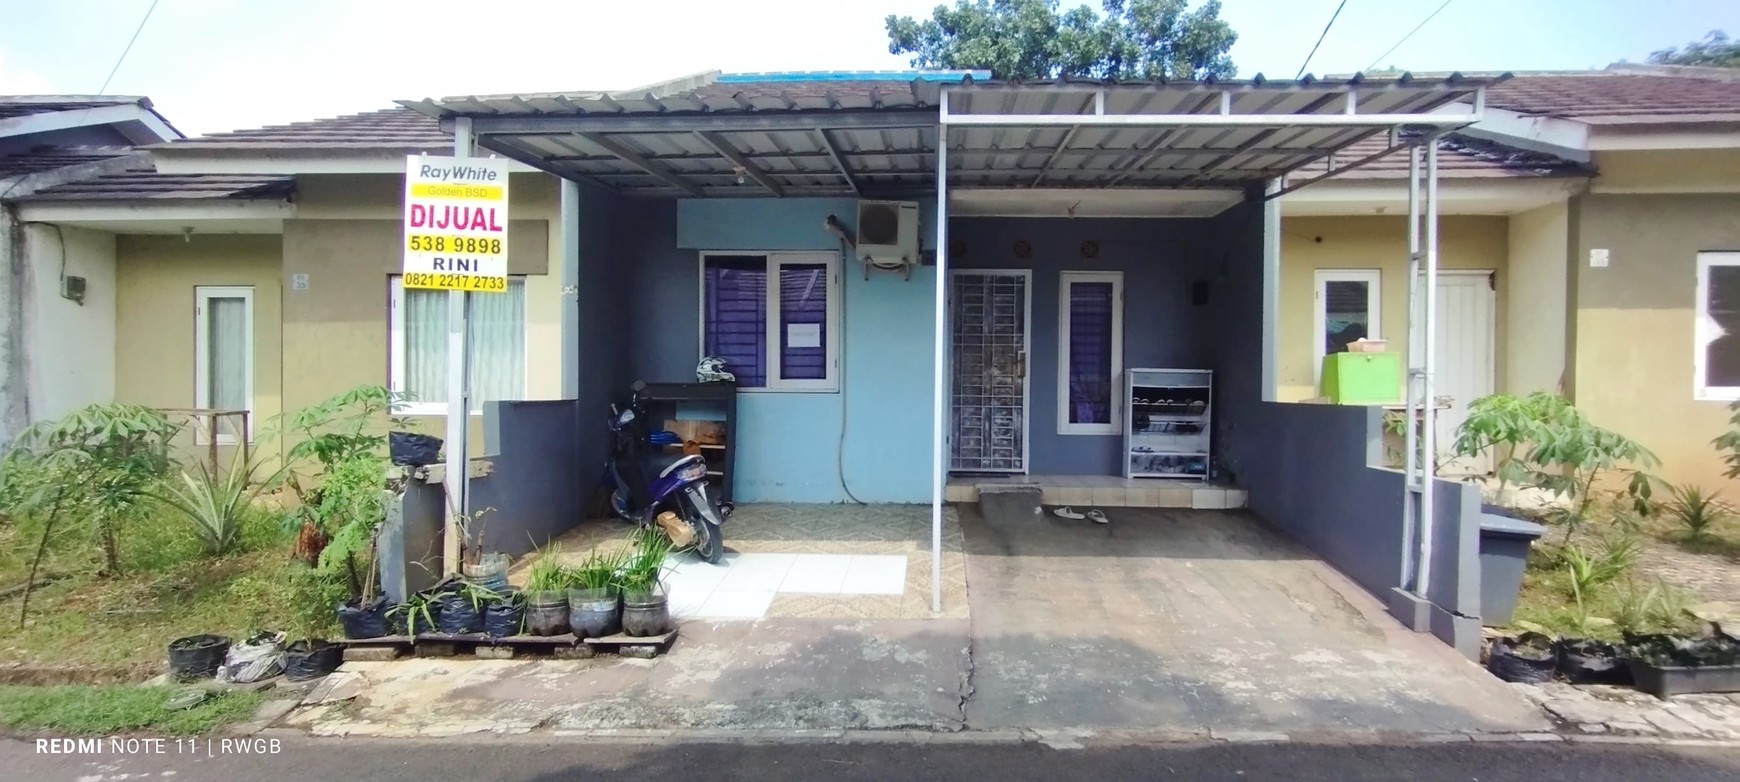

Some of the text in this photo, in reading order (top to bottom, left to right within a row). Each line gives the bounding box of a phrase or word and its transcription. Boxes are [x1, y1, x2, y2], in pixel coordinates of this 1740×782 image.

[428, 185, 488, 198] Golden BSD
[410, 203, 503, 232] DIJUAL
[411, 235, 501, 254] 538 9898
[433, 257, 478, 272] RINI
[405, 272, 504, 289] 0821 2217 2733
